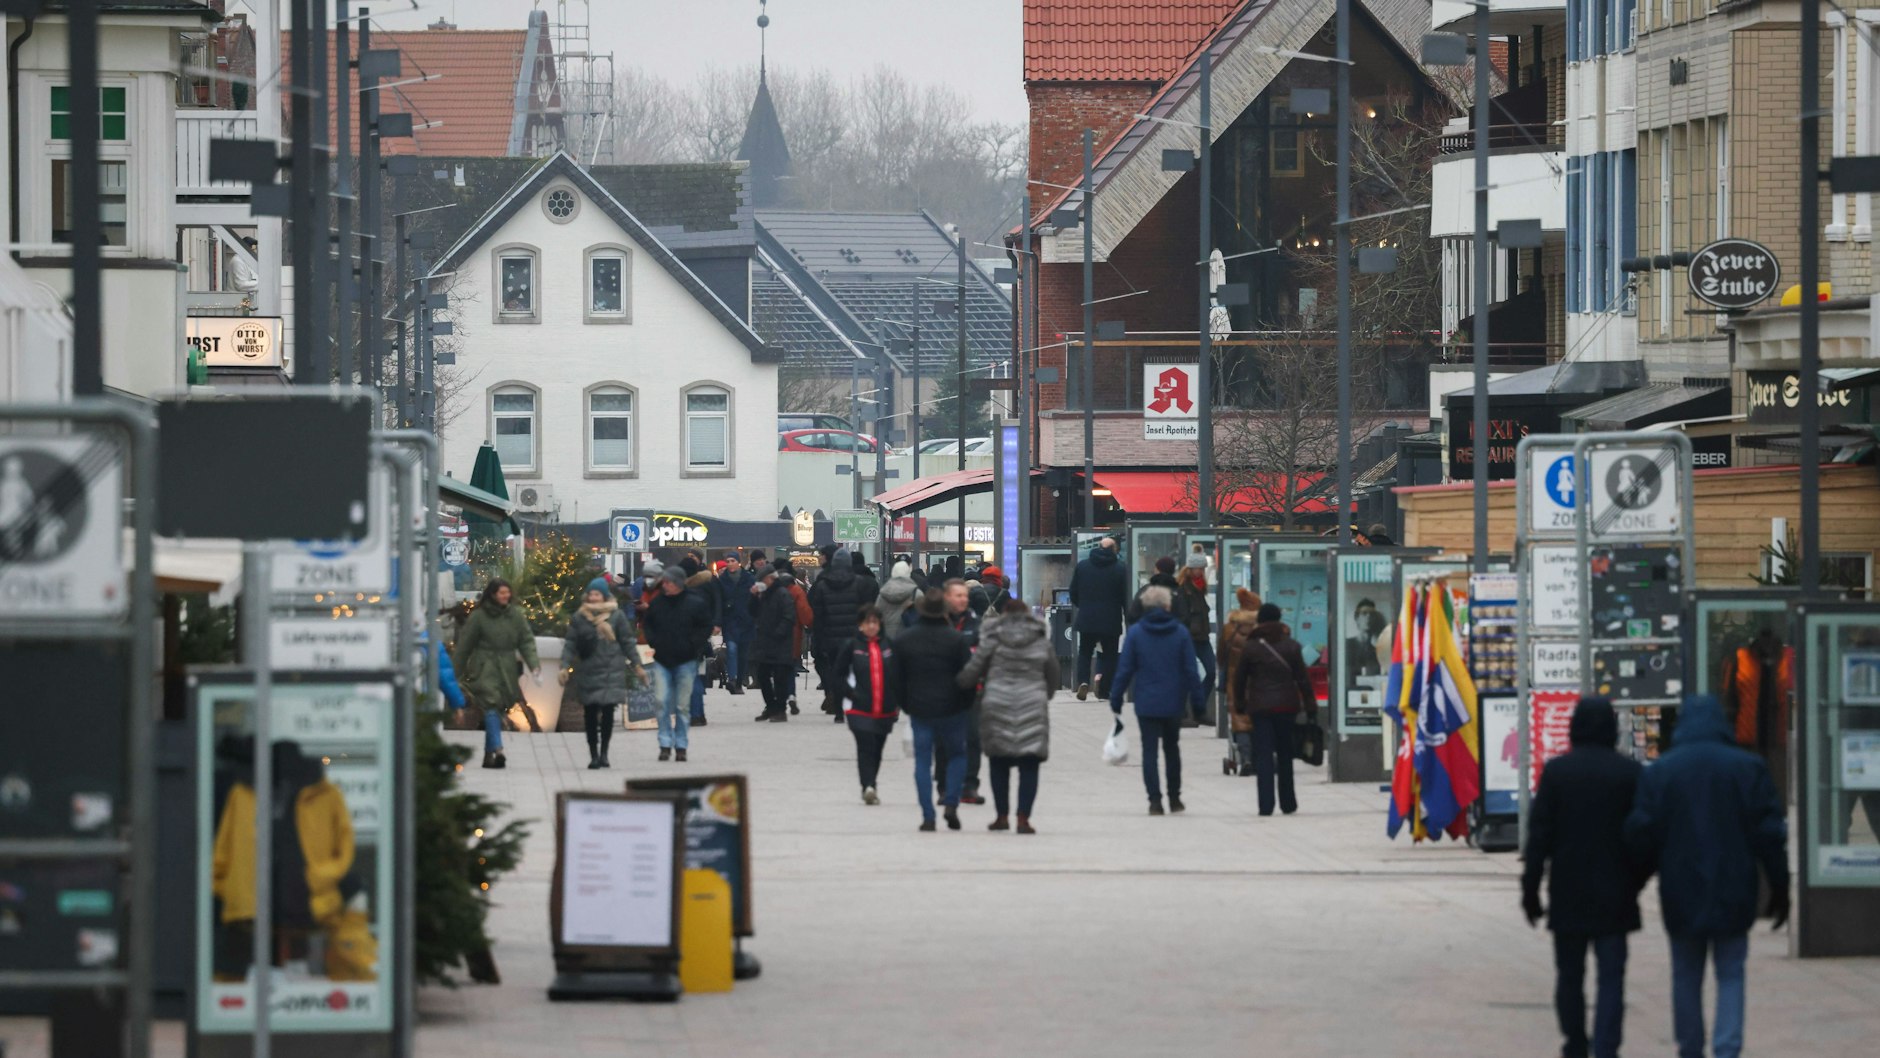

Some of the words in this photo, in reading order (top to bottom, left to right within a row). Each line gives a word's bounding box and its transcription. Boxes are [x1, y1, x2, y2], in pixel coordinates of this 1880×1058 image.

[1702, 251, 1766, 276] Jever
[1701, 276, 1766, 296] Stube
[237, 330, 264, 338] OTTO
[237, 345, 264, 353] WURST
[869, 530, 877, 538] 20
